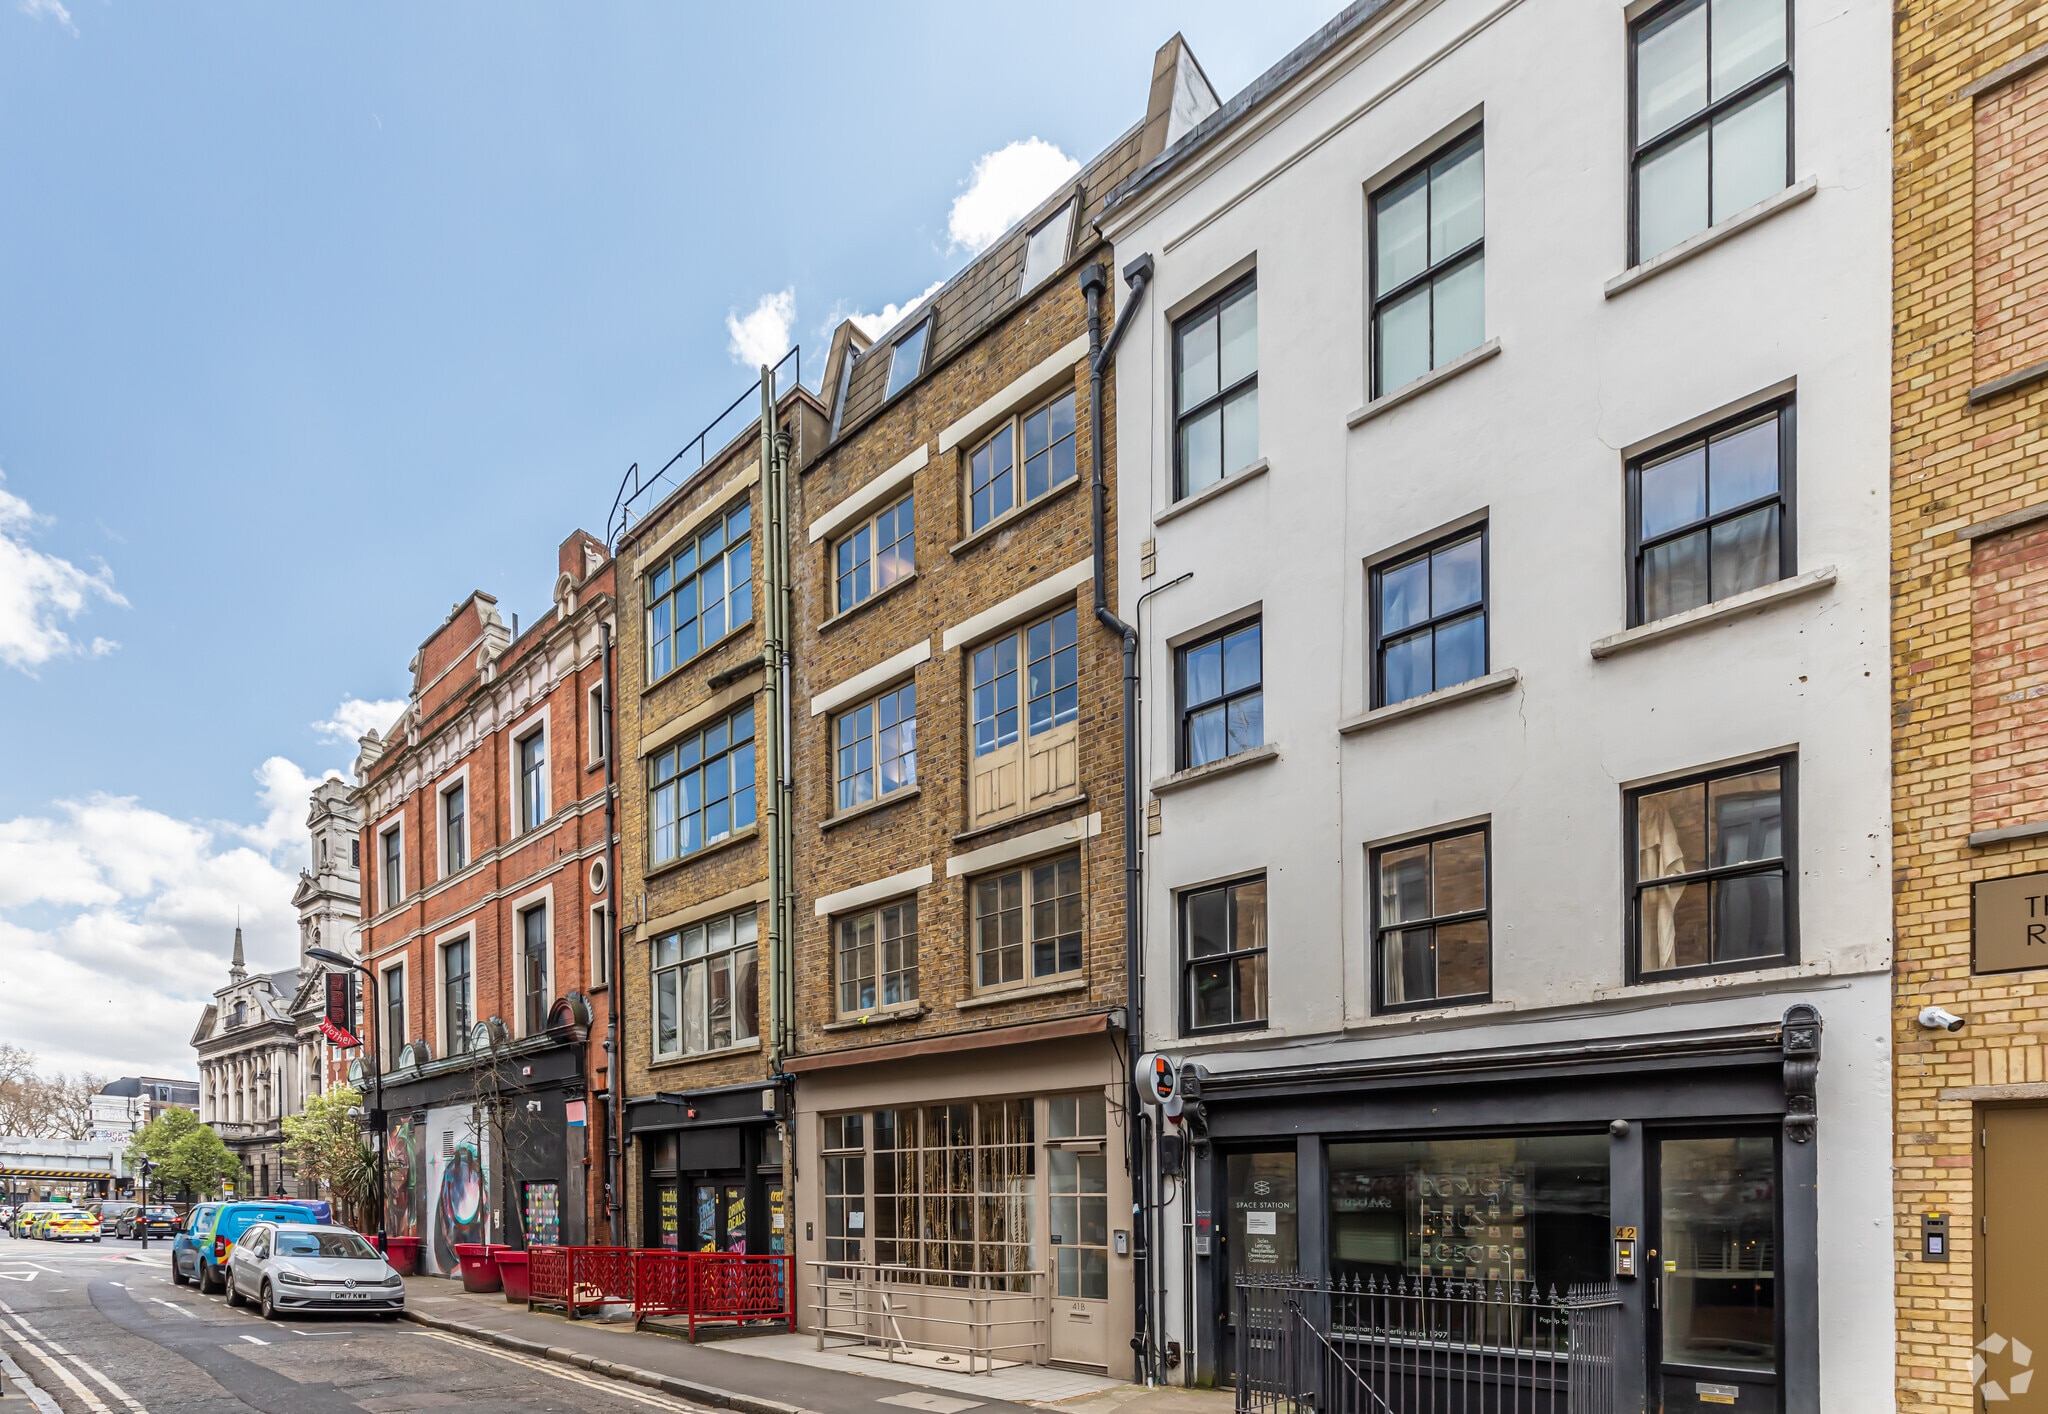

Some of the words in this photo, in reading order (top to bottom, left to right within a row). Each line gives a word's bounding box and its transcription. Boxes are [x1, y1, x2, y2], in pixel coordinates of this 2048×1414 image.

[2024, 894, 2048, 918] T
[323, 1022, 353, 1045] Mother
[728, 1197, 746, 1219] DRINK
[727, 1210, 746, 1232] DEALS
[1616, 1228, 1635, 1239] 42
[1072, 1302, 1086, 1311] 41B
[1332, 1322, 1373, 1335] Extaordnary
[1375, 1327, 1408, 1336] Proertis
[1429, 1330, 1449, 1339] 1997
